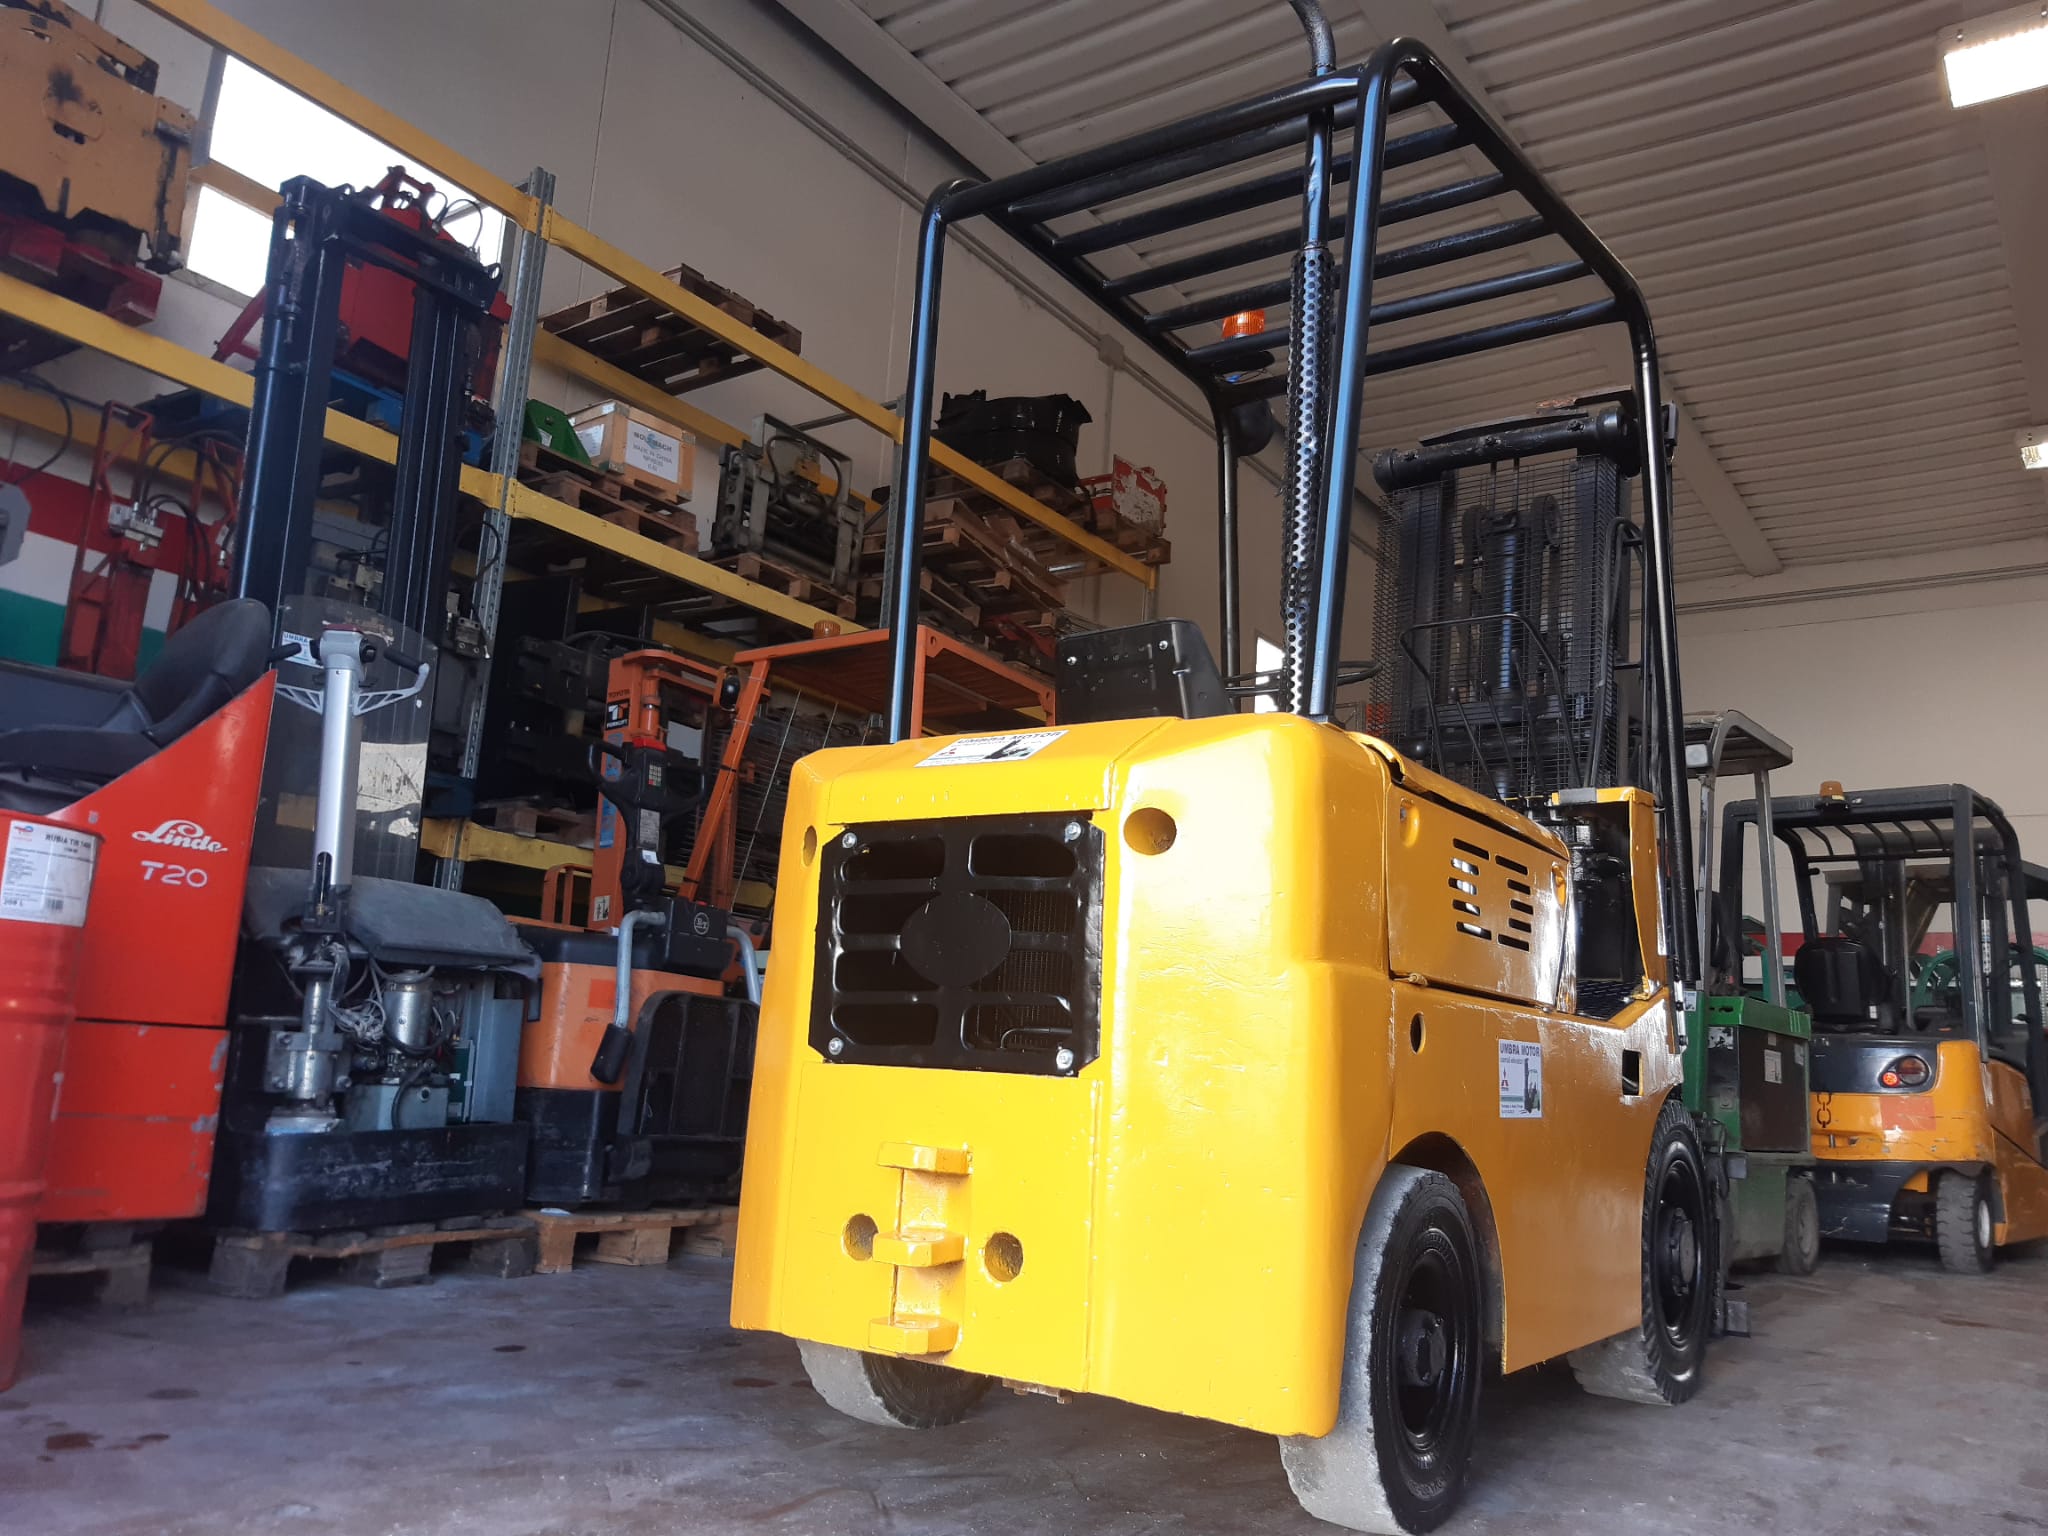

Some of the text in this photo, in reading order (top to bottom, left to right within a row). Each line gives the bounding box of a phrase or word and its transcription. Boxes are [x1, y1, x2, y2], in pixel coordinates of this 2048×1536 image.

[1010, 731, 1064, 740] MOTOR
[131, 819, 228, 852] Linde
[141, 860, 208, 888] T20
[1500, 1043, 1540, 1057] UMBRA MOTOR
